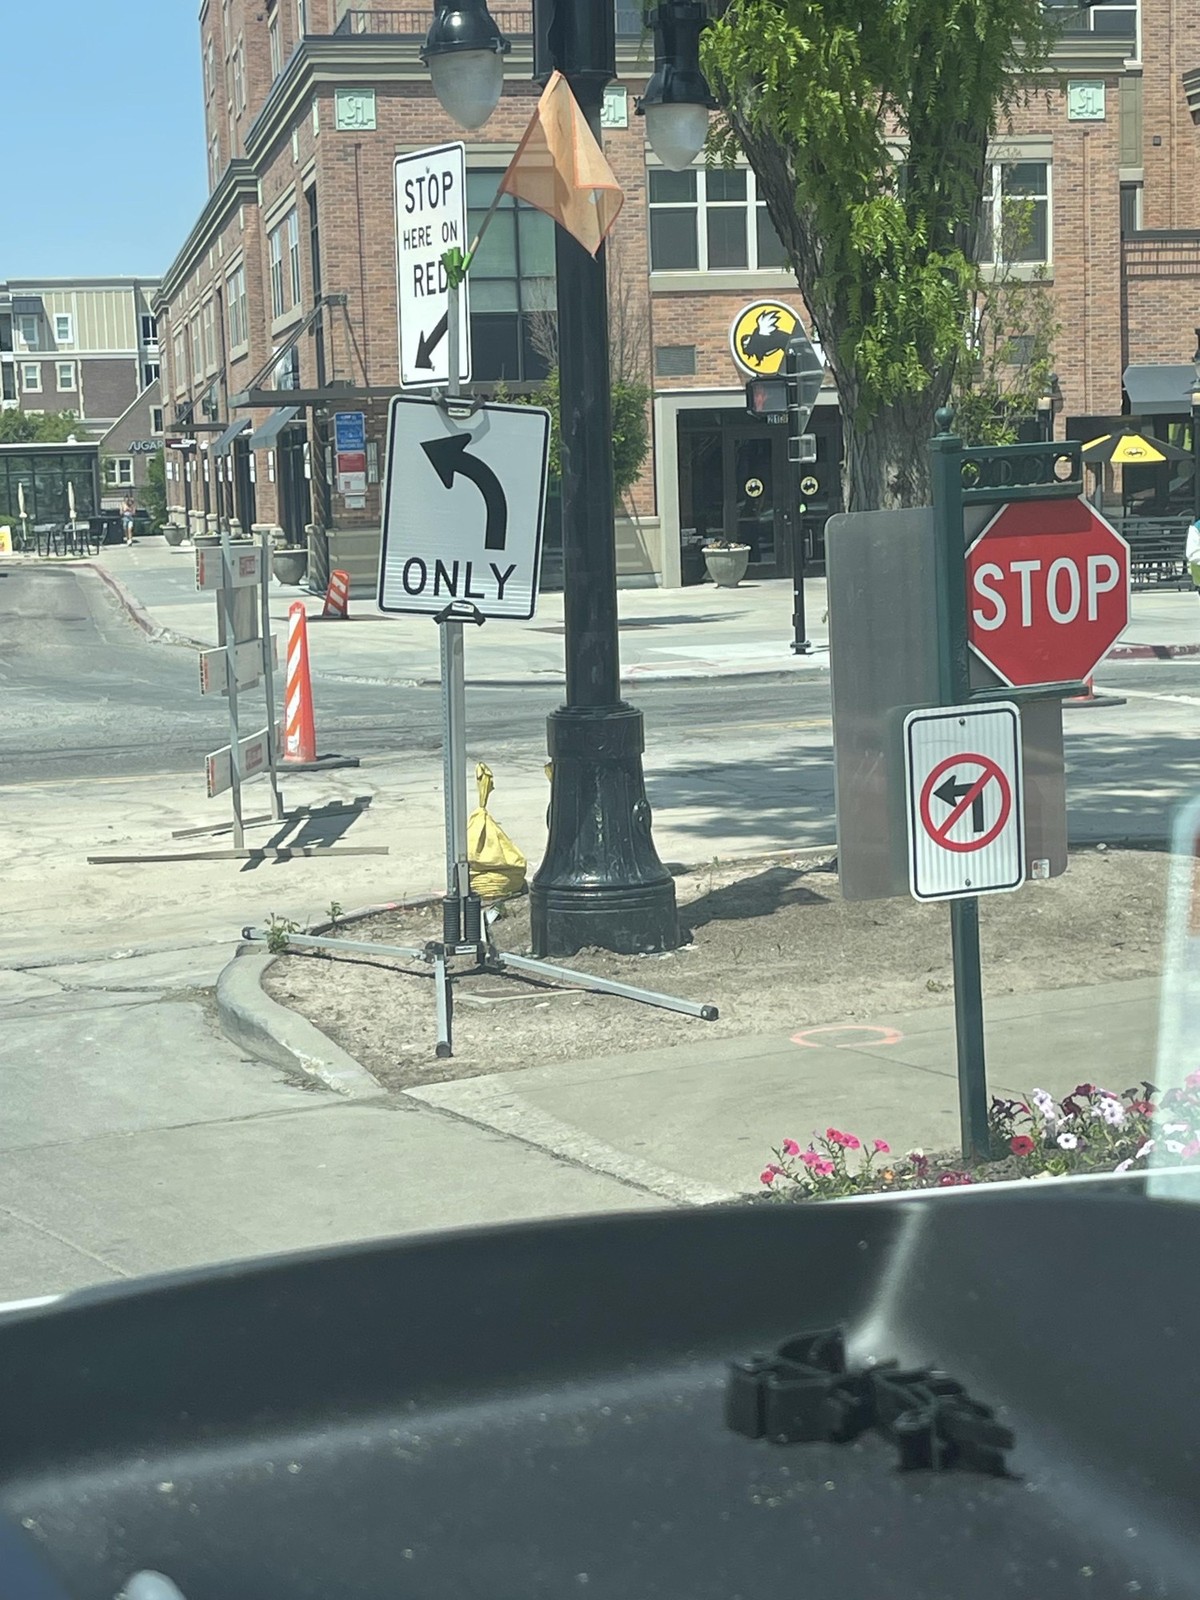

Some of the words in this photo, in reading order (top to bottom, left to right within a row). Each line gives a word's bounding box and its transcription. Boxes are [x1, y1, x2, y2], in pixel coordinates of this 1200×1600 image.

[405, 171, 453, 213] STOP
[403, 225, 432, 250] HERE
[441, 220, 458, 243] ON
[413, 260, 449, 297] RED
[402, 557, 517, 600] ONLY
[972, 554, 1120, 631] STOP
